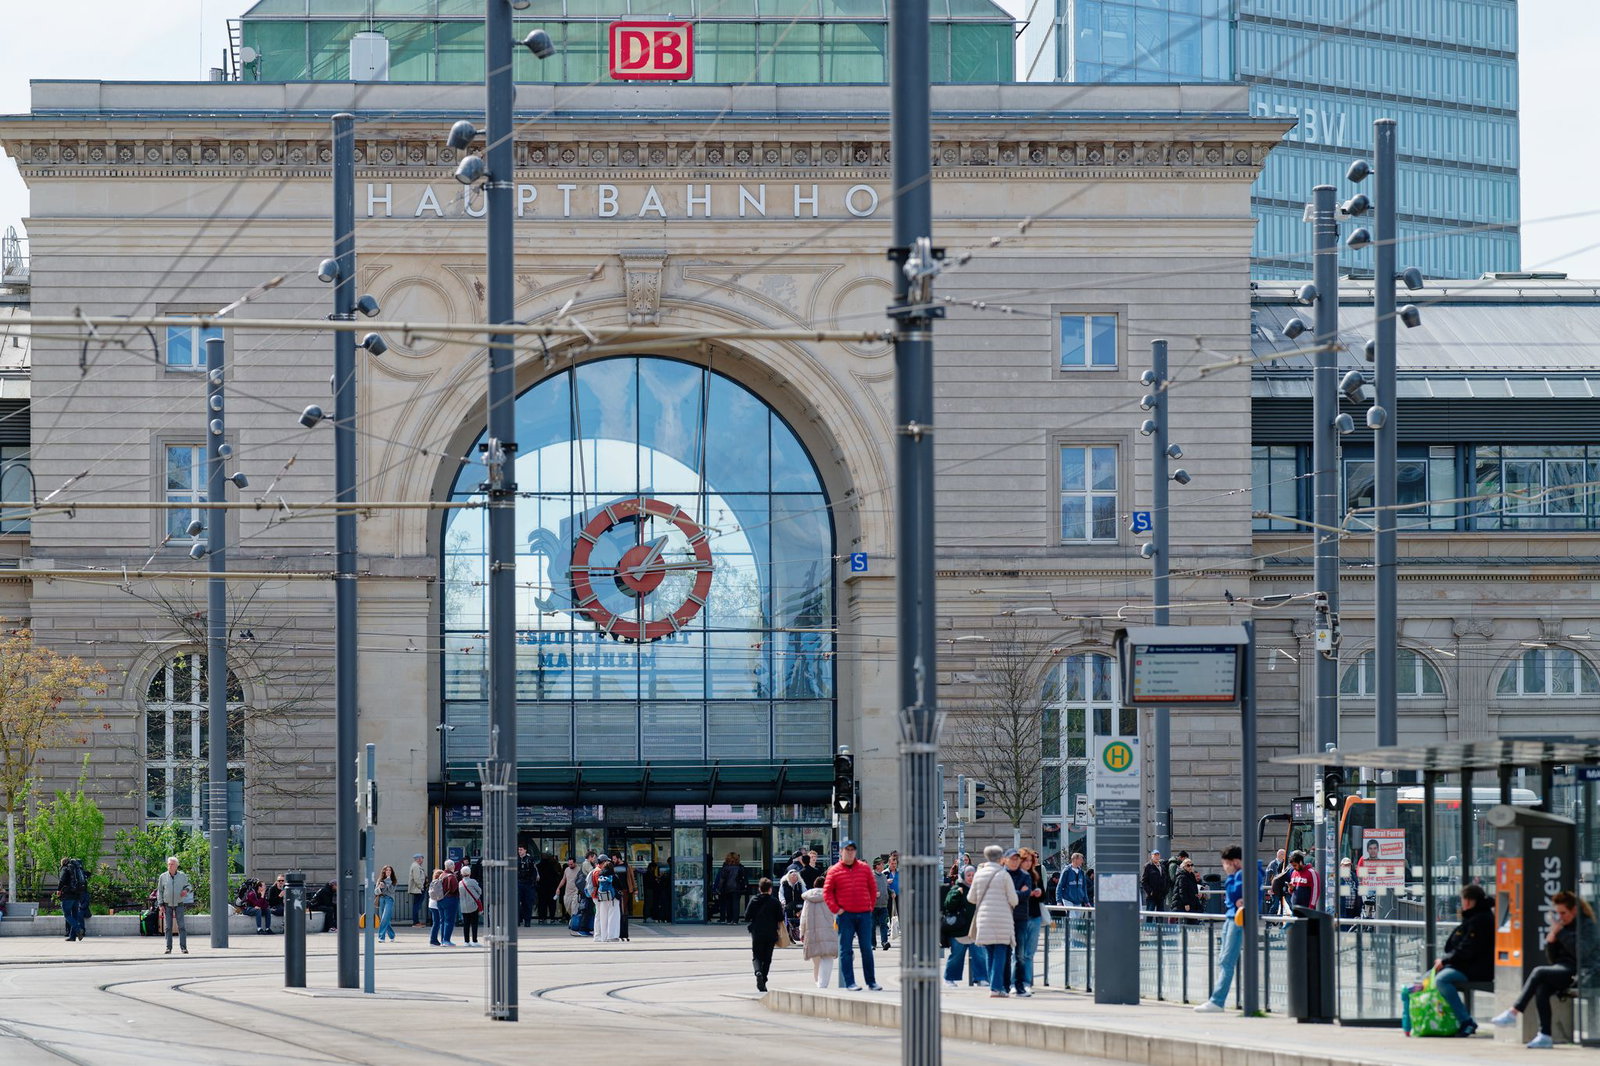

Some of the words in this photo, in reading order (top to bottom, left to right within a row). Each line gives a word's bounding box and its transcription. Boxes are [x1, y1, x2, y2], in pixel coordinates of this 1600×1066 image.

[621, 31, 683, 70] DB
[367, 183, 879, 217] HAUPTBAHNHO
[1136, 513, 1148, 530] S
[854, 554, 865, 570] S
[538, 652, 657, 668] MANNHEIM
[1111, 748, 1124, 765] H
